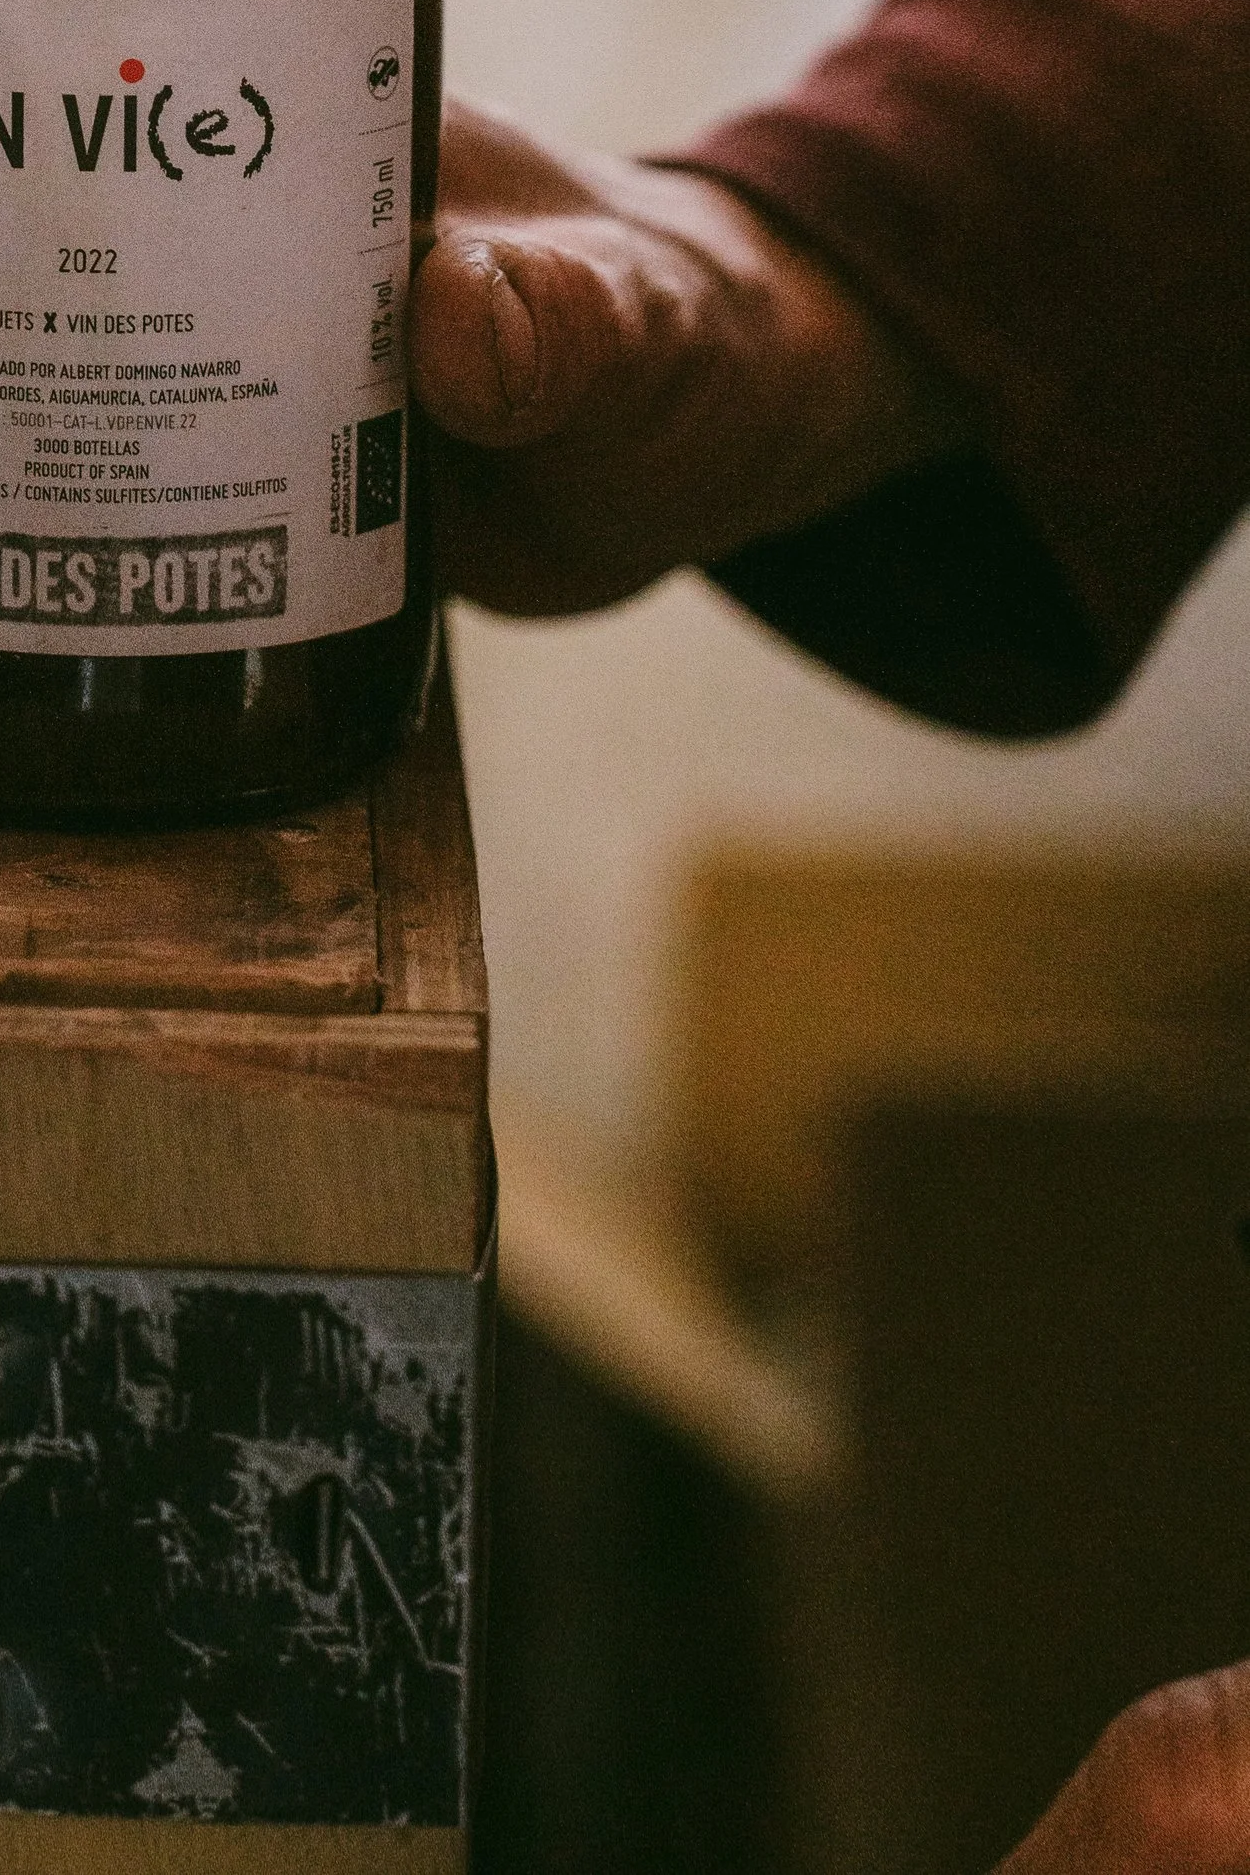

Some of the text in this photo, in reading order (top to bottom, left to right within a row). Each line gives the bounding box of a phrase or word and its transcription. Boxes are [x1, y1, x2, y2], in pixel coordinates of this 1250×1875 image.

[372, 156, 395, 229] 750 ml
[58, 247, 118, 275] 2022
[66, 314, 97, 334] VIN
[104, 314, 137, 334] DES
[142, 313, 194, 334] POTES
[371, 311, 394, 334] %
[371, 334, 393, 363] 10
[30, 362, 56, 379] POR
[59, 363, 111, 381] ALBERT
[115, 363, 177, 381] DOMINGO
[181, 359, 241, 379] NAVARRO
[231, 377, 279, 401] ESPAÑA
[33, 438, 140, 456] 3000 BOTELLAS
[24, 461, 150, 480] PRODUCT OF SPAIN
[25, 485, 92, 504] CONTAINS
[232, 477, 288, 498] SULFITOS
[0, 547, 98, 614] DES
[119, 539, 276, 614] POTES
